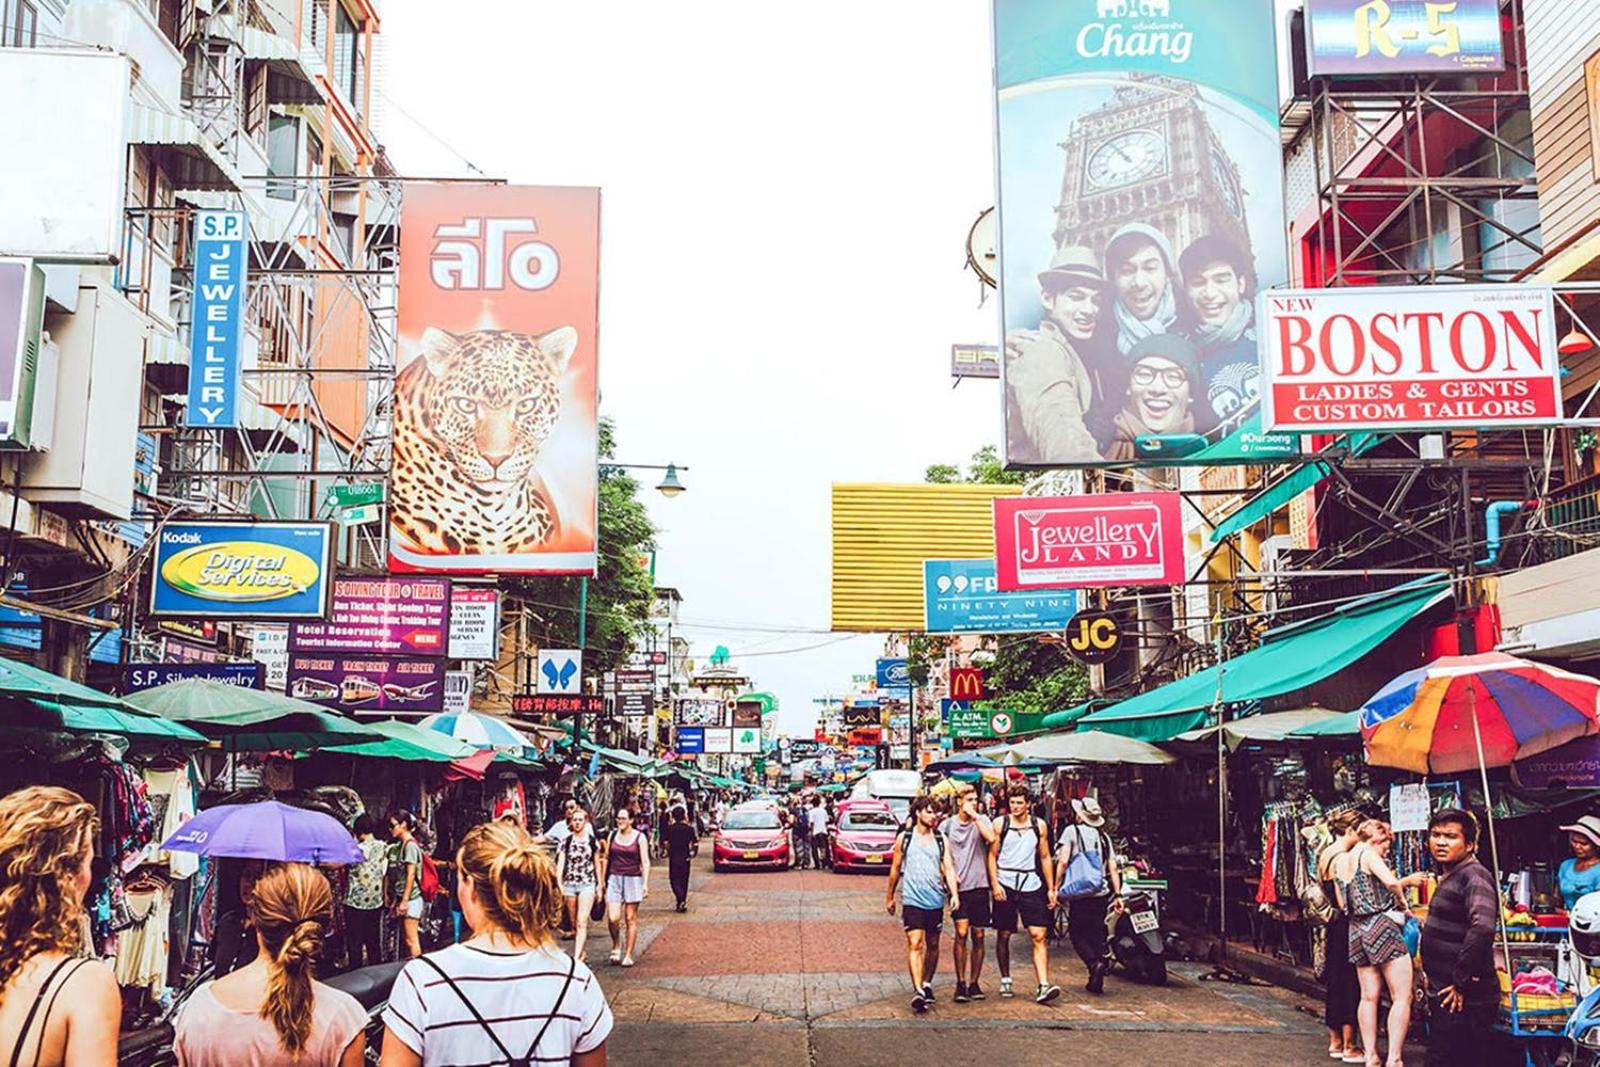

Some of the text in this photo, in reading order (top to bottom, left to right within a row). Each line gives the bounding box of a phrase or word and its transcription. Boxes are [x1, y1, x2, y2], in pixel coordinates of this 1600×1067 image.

[1076, 22, 1194, 63] Chang
[204, 215, 238, 237] S.P.
[429, 216, 561, 292] ลีโอ
[1273, 299, 1314, 313] NEW
[198, 243, 236, 424] JEWELLERY
[1274, 309, 1543, 378] BOSTON
[1298, 381, 1529, 401] LADIES & GENTS
[1293, 400, 1537, 421] CUSTOM TAILORS
[163, 532, 200, 544] Kodak
[1044, 543, 1138, 563] LAND
[207, 553, 287, 573] Digital
[197, 568, 293, 587] Services
[345, 582, 376, 597] DIVING
[376, 582, 401, 598] TOUR
[412, 584, 445, 600] TRAVEL
[425, 604, 443, 613] Tour
[938, 599, 1072, 611] NINETY NINE
[297, 625, 391, 637] Hotel Reservation
[1071, 618, 1118, 650] JC
[296, 638, 402, 649] Tourist Information Center
[310, 659, 335, 671] TICKET
[366, 661, 389, 673] TICKET
[411, 663, 436, 674] TICKET
[132, 670, 162, 686] S.P.
